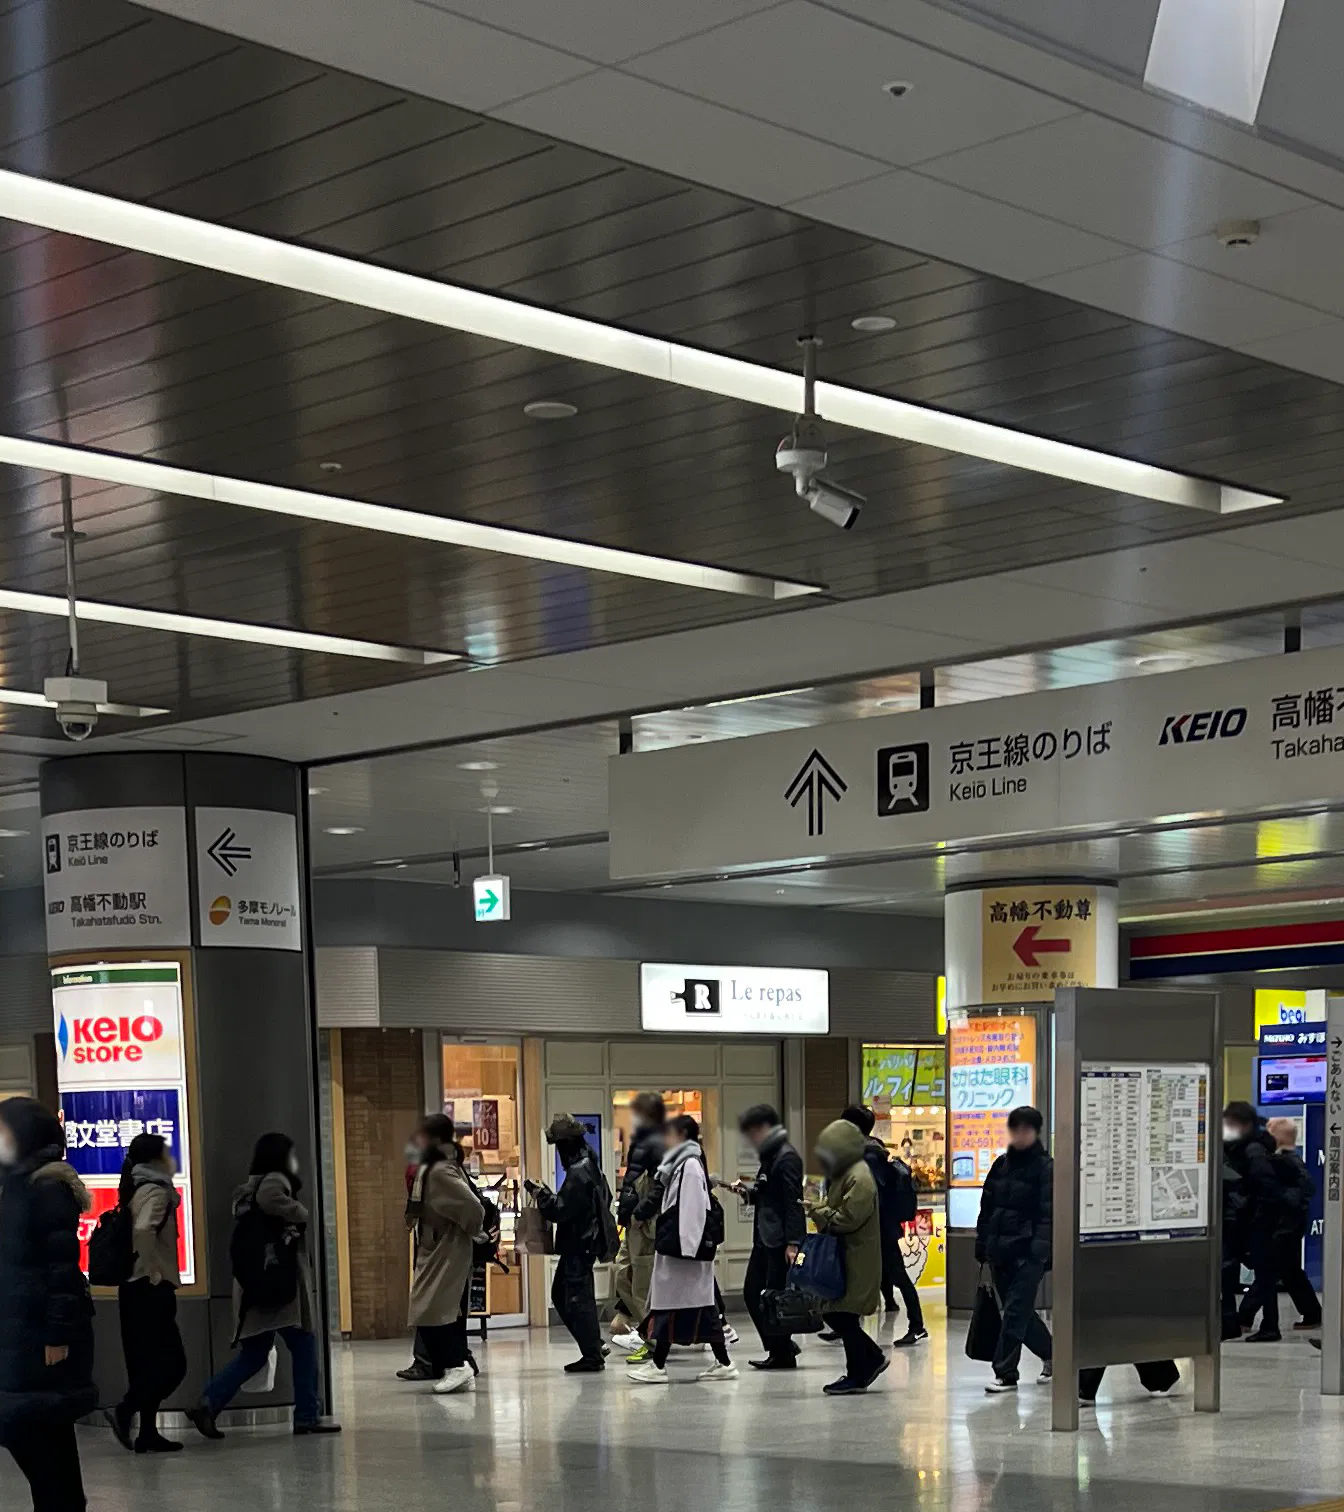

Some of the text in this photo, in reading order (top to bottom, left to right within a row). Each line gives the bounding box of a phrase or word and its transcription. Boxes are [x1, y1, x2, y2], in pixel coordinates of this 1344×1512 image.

[1158, 707, 1248, 746] KEIO
[948, 720, 1113, 775] 京王線のりば
[992, 776, 1028, 797] Line
[67, 830, 159, 853] 京王線のりば
[88, 854, 108, 866] Line
[70, 892, 147, 913] 高幡不動駅
[989, 898, 1092, 924] 高幡不動尊
[139, 913, 162, 925] Stn.
[731, 980, 754, 1001] Le
[759, 985, 803, 1007] repas
[1297, 1031, 1326, 1045] みずほ
[74, 1043, 144, 1065] store
[1329, 1050, 1343, 1116] ごあんない
[957, 1088, 1015, 1109] クリニック
[1328, 1135, 1341, 1201] 周辺案内図
